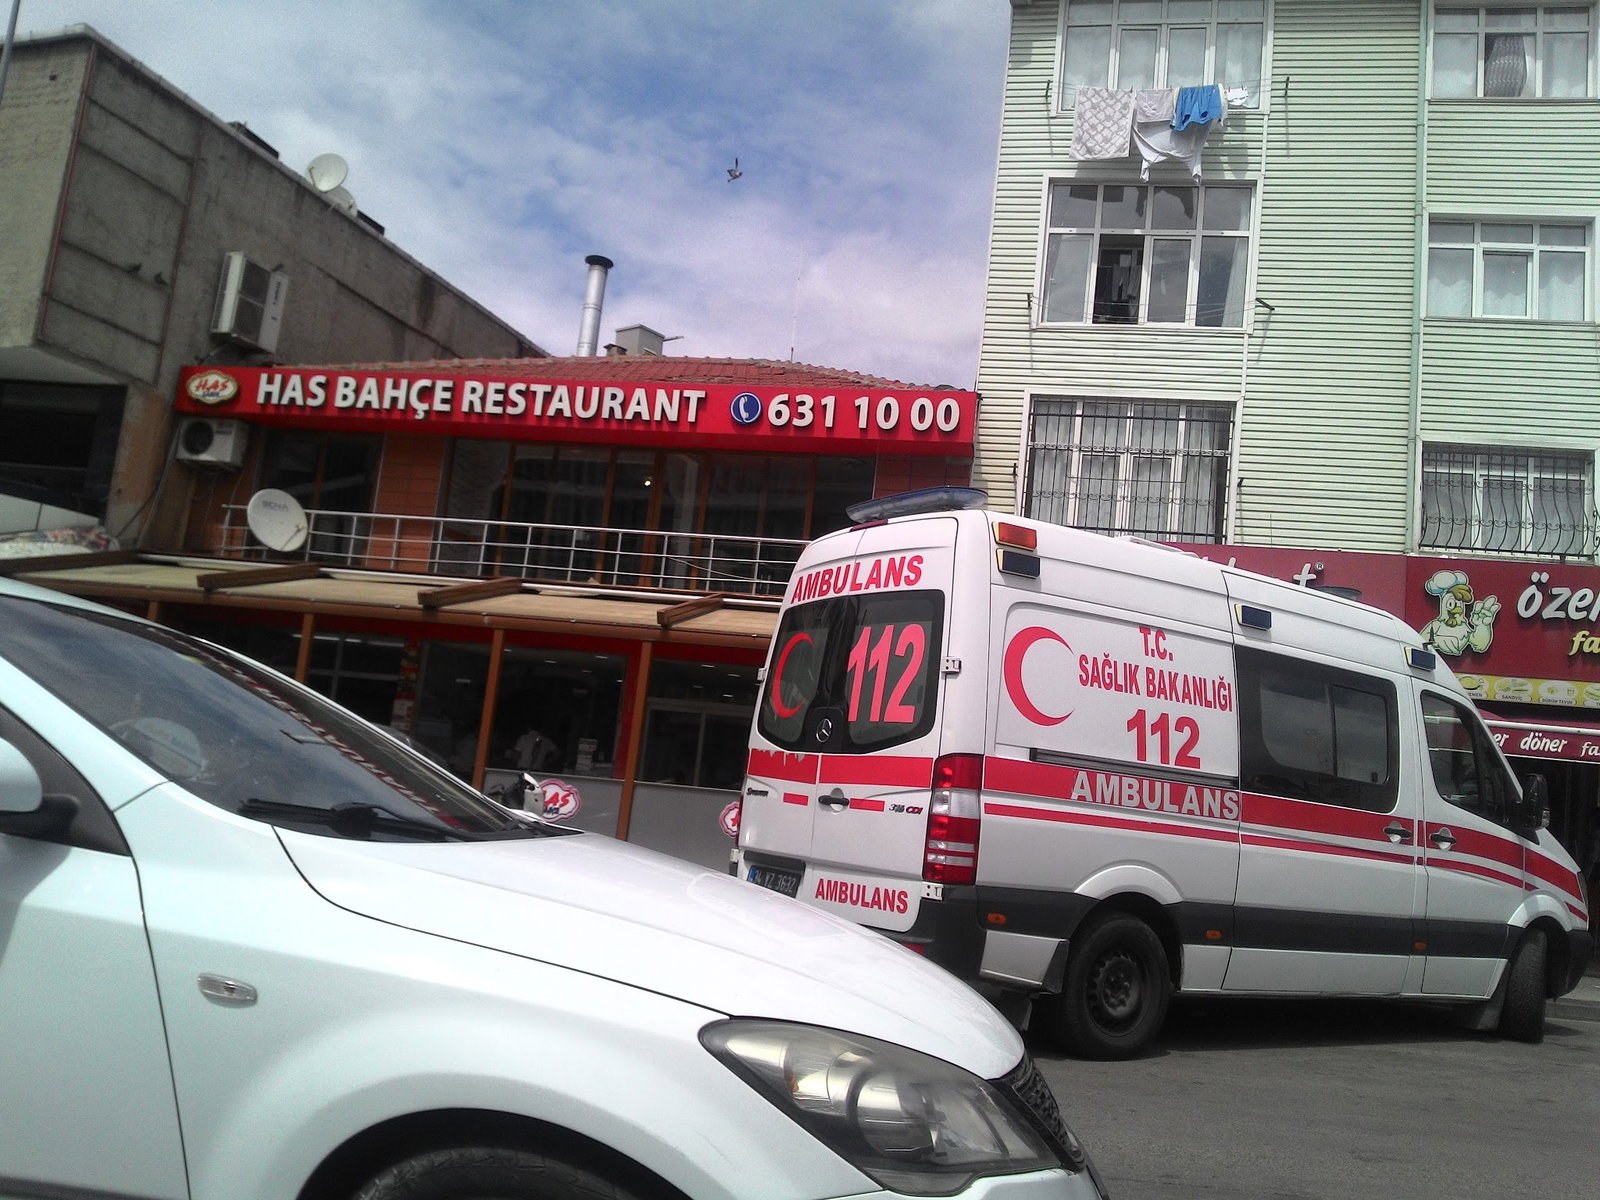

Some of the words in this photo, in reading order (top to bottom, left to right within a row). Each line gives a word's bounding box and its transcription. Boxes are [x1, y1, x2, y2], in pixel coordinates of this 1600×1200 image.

[194, 379, 232, 392] HAS
[256, 372, 328, 407] HAS
[334, 375, 454, 420] BAHÇE
[461, 380, 706, 423] RESTAURANT
[768, 393, 836, 428] 631
[855, 396, 900, 430] 10
[910, 397, 960, 432] 00
[790, 555, 924, 604] AMBULANS
[1138, 625, 1174, 662] T.C.
[847, 623, 926, 724] 112
[1078, 652, 1141, 696] SAĞLIK
[1145, 666, 1233, 713] BAKANLIĞI
[1126, 708, 1201, 770] 112
[1492, 732, 1510, 748] er
[1520, 731, 1568, 753] döner
[1580, 741, 1600, 757] fa
[544, 789, 571, 809] AS
[1070, 770, 1240, 820] AMBULANS
[814, 878, 909, 914] AMBULANS
